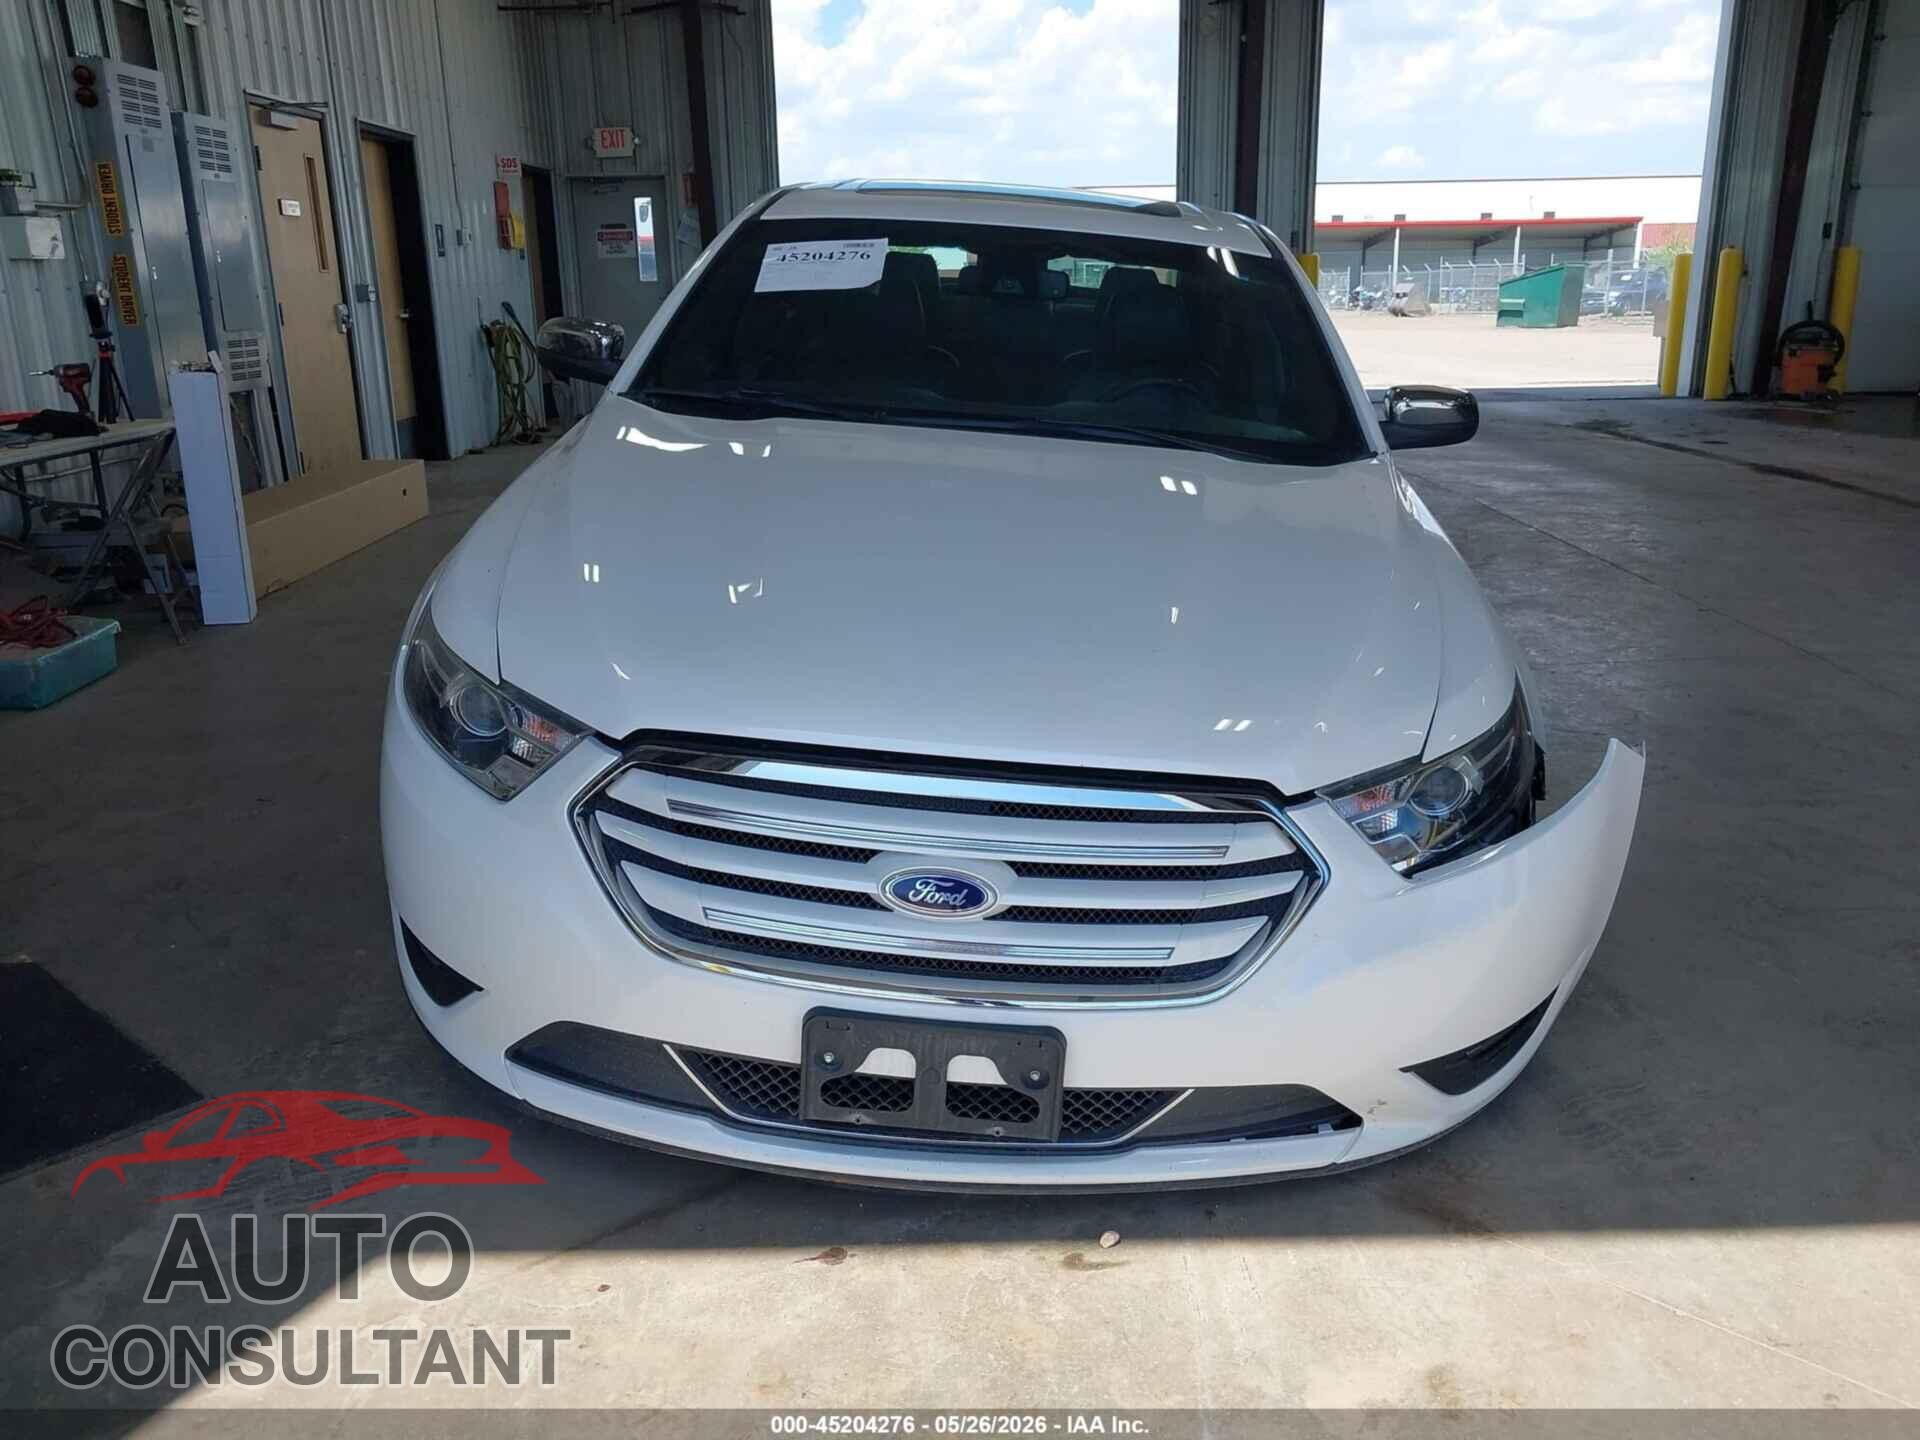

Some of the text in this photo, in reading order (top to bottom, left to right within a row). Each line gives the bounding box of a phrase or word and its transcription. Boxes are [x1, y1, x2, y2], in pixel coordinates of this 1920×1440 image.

[601, 129, 625, 149] EXIT
[98, 163, 121, 235] STUDENT DRIVER
[776, 250, 871, 262] 45204276
[113, 255, 137, 325] STUDENT DRIVER
[908, 878, 968, 906] Ford
